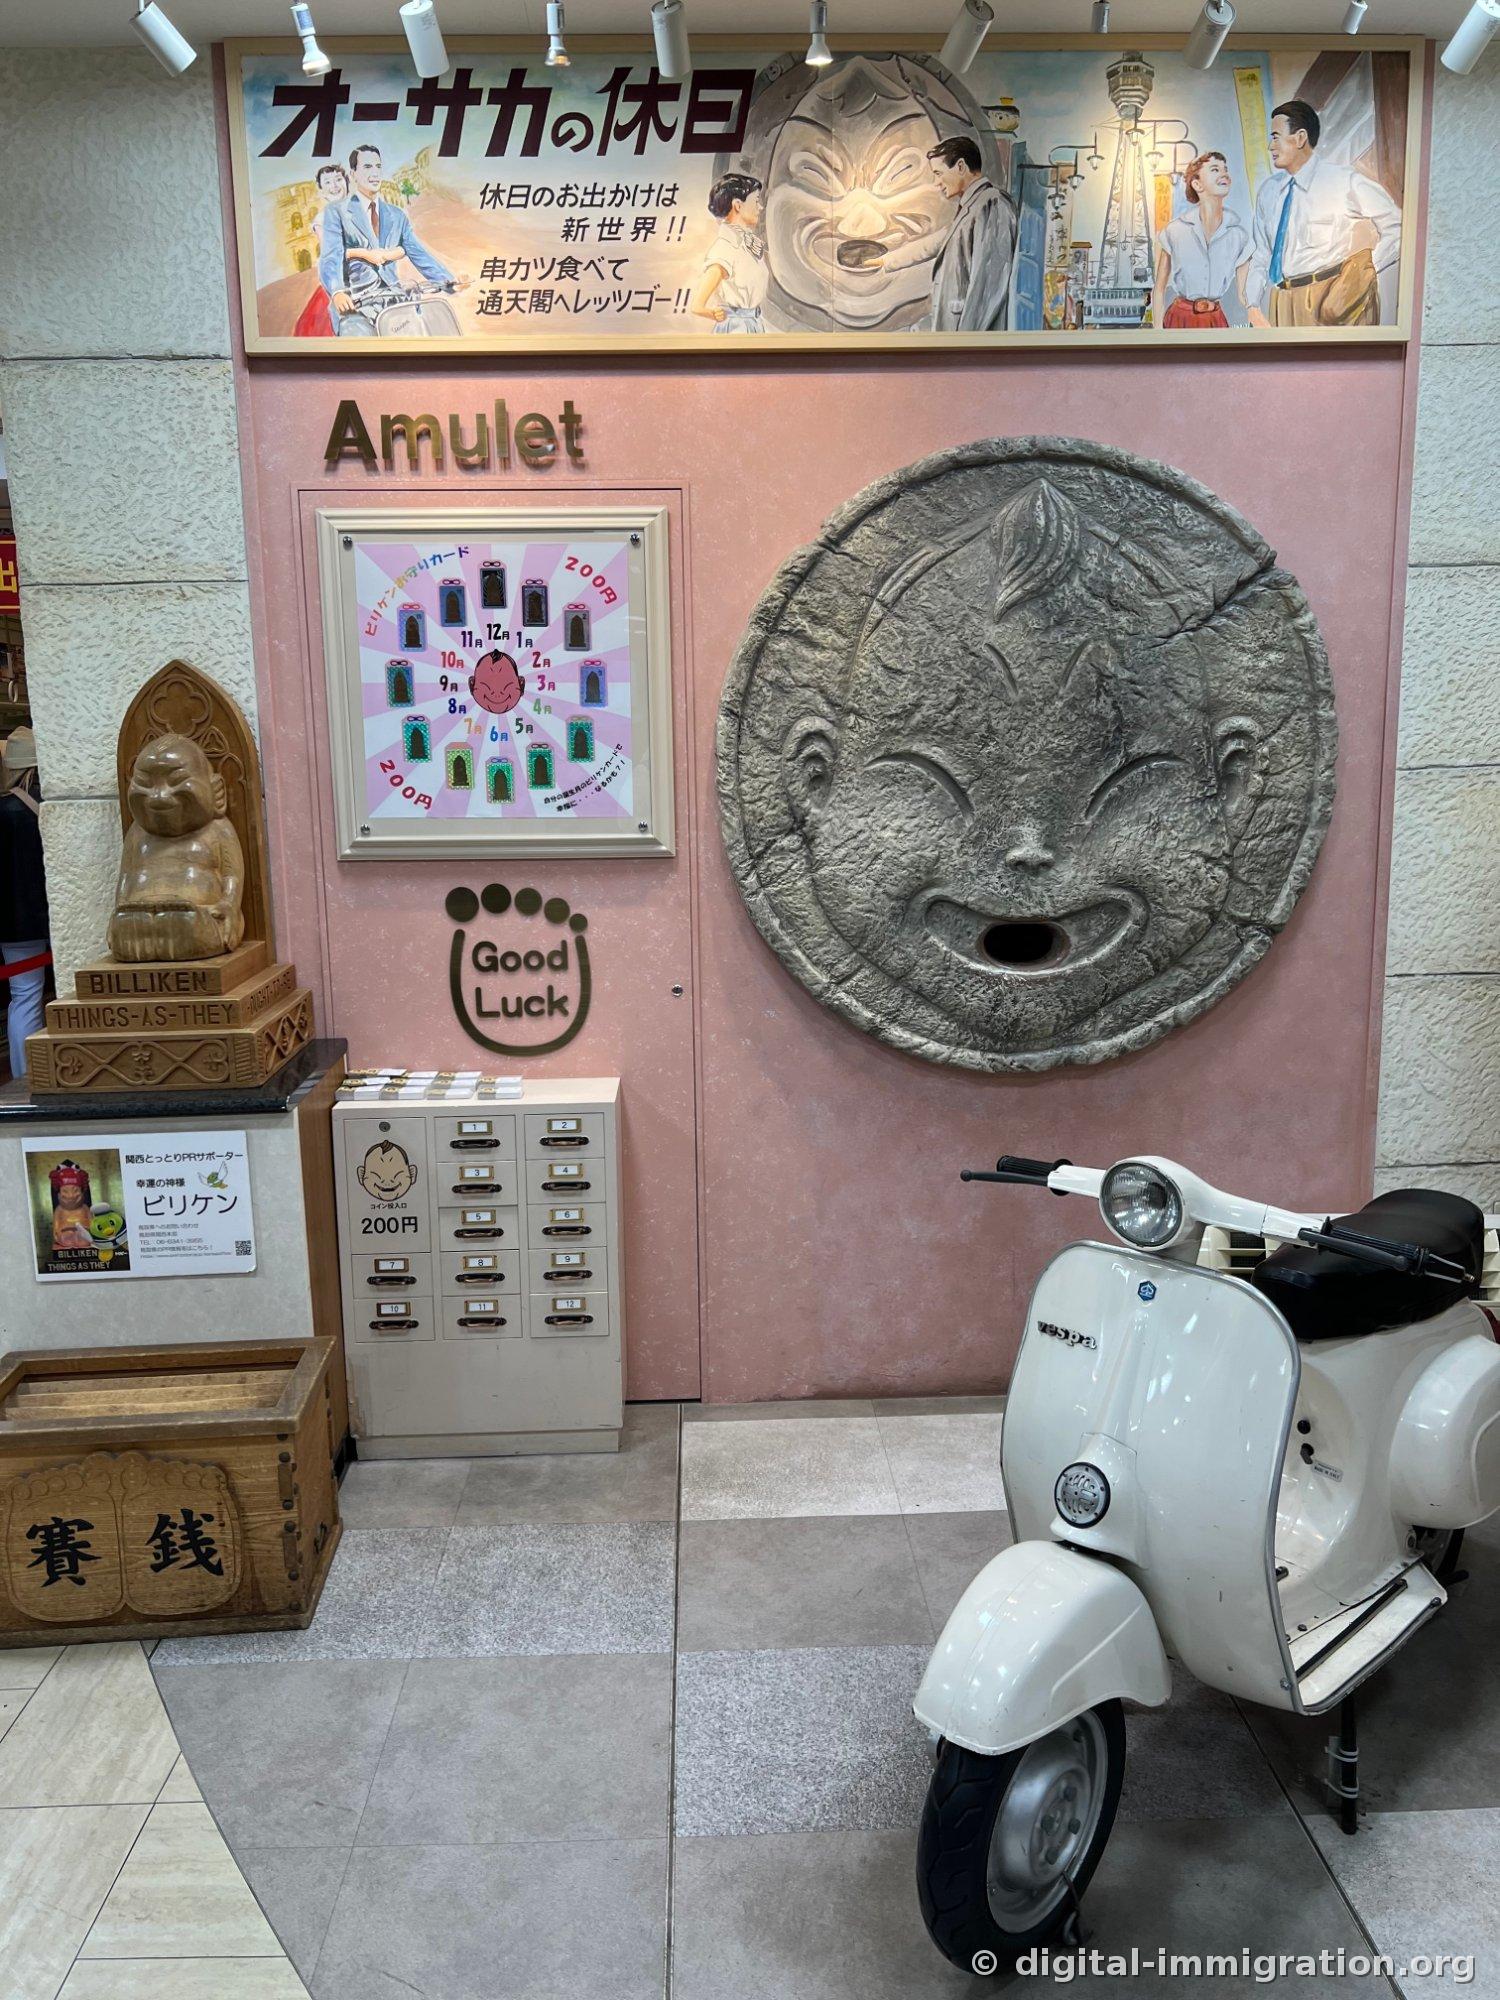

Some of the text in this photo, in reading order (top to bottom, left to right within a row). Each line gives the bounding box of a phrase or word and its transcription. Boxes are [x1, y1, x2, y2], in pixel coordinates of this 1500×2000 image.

[258, 67, 757, 158] オーサカの休日
[479, 182, 680, 209] 休日のお出かけは
[480, 255, 630, 282] 串カツ食べて
[324, 398, 585, 461] Amulet
[565, 556, 618, 605] 200円
[461, 631, 483, 648] 11月
[487, 623, 510, 640] 12月
[517, 631, 533, 648] 1月
[441, 651, 464, 668] 10月
[532, 651, 551, 668] 2月
[439, 675, 458, 692] 9月
[537, 675, 556, 691] 3月
[448, 698, 467, 714] 8月
[533, 699, 552, 714] 4月
[464, 718, 482, 734] 7月
[490, 726, 509, 742] 6月
[515, 718, 534, 734] 5月
[379, 759, 432, 810] 200円
[471, 940, 568, 973] Good
[90, 971, 207, 995] BILLIKEN
[475, 985, 569, 1019] Luck
[53, 1003, 234, 1029] THINGS-AS-THEY
[472, 1123, 478, 1131] 1
[561, 1121, 568, 1129] 2
[125, 1151, 244, 1164] 関西とっとりPRサポーター
[474, 1169, 480, 1177] 3
[136, 1178, 186, 1189] 幸運の神様
[143, 1194, 238, 1216] ビリケン
[370, 1202, 408, 1210] コイン投入口
[475, 1212, 481, 1220] 5
[564, 1211, 570, 1219] 6
[361, 1216, 418, 1234] 200円
[57, 1248, 98, 1259] BILLIKEN
[564, 1255, 571, 1263] 9
[48, 1260, 111, 1272] THINGS AS THEY
[389, 1261, 395, 1269] 7
[477, 1259, 484, 1267] 8
[390, 1305, 399, 1313] 10
[478, 1303, 486, 1311] 11
[566, 1300, 574, 1308] 12
[1037, 1320, 1098, 1350] vespa
[26, 1508, 225, 1588] 賽銭
